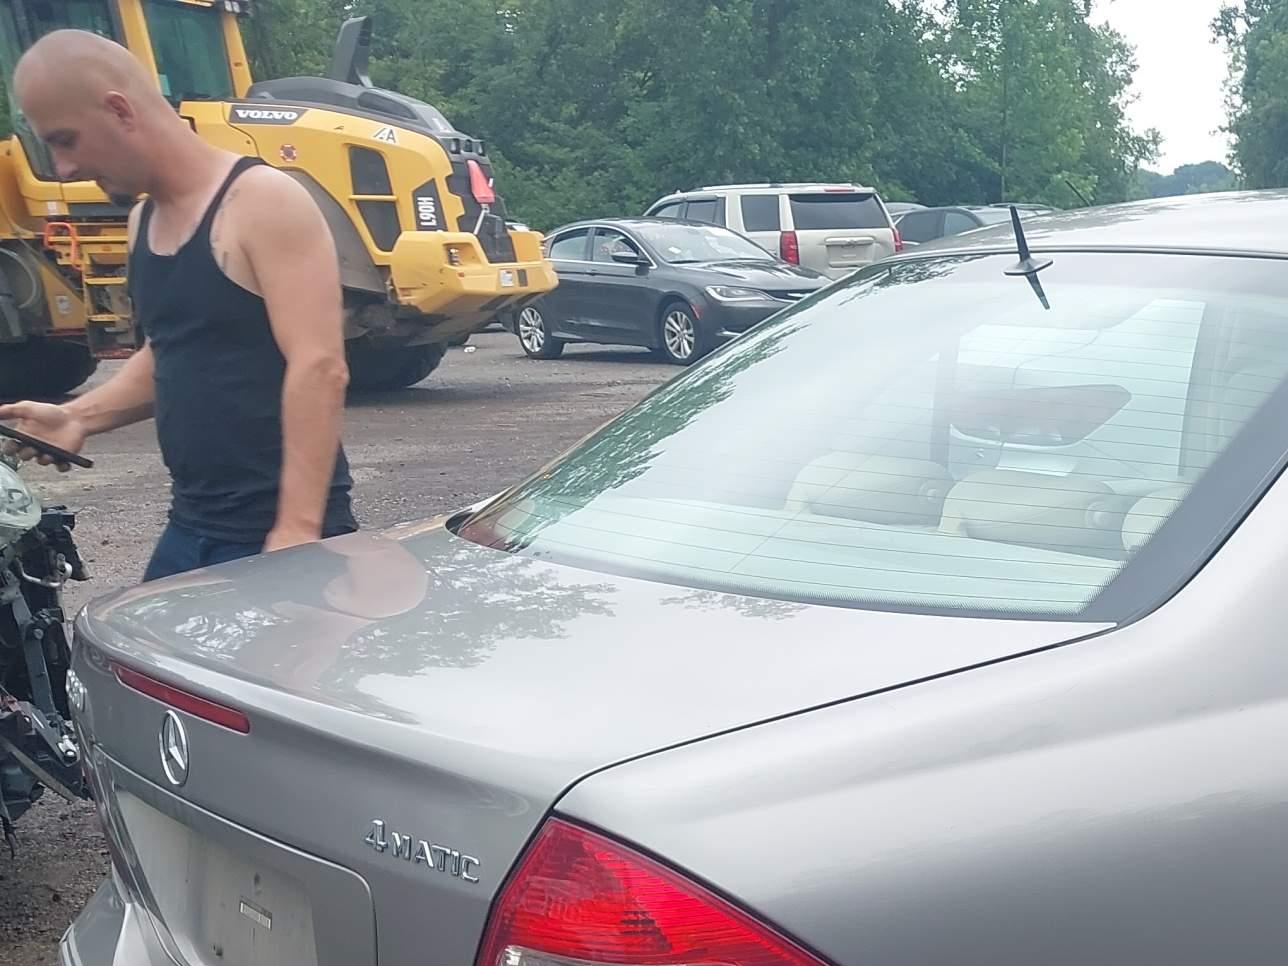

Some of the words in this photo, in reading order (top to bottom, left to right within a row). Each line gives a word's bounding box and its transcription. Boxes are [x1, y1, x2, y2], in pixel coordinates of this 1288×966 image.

[234, 109, 298, 120] VOLVO
[416, 196, 437, 227] L90H
[364, 819, 480, 883] 4MATIC
